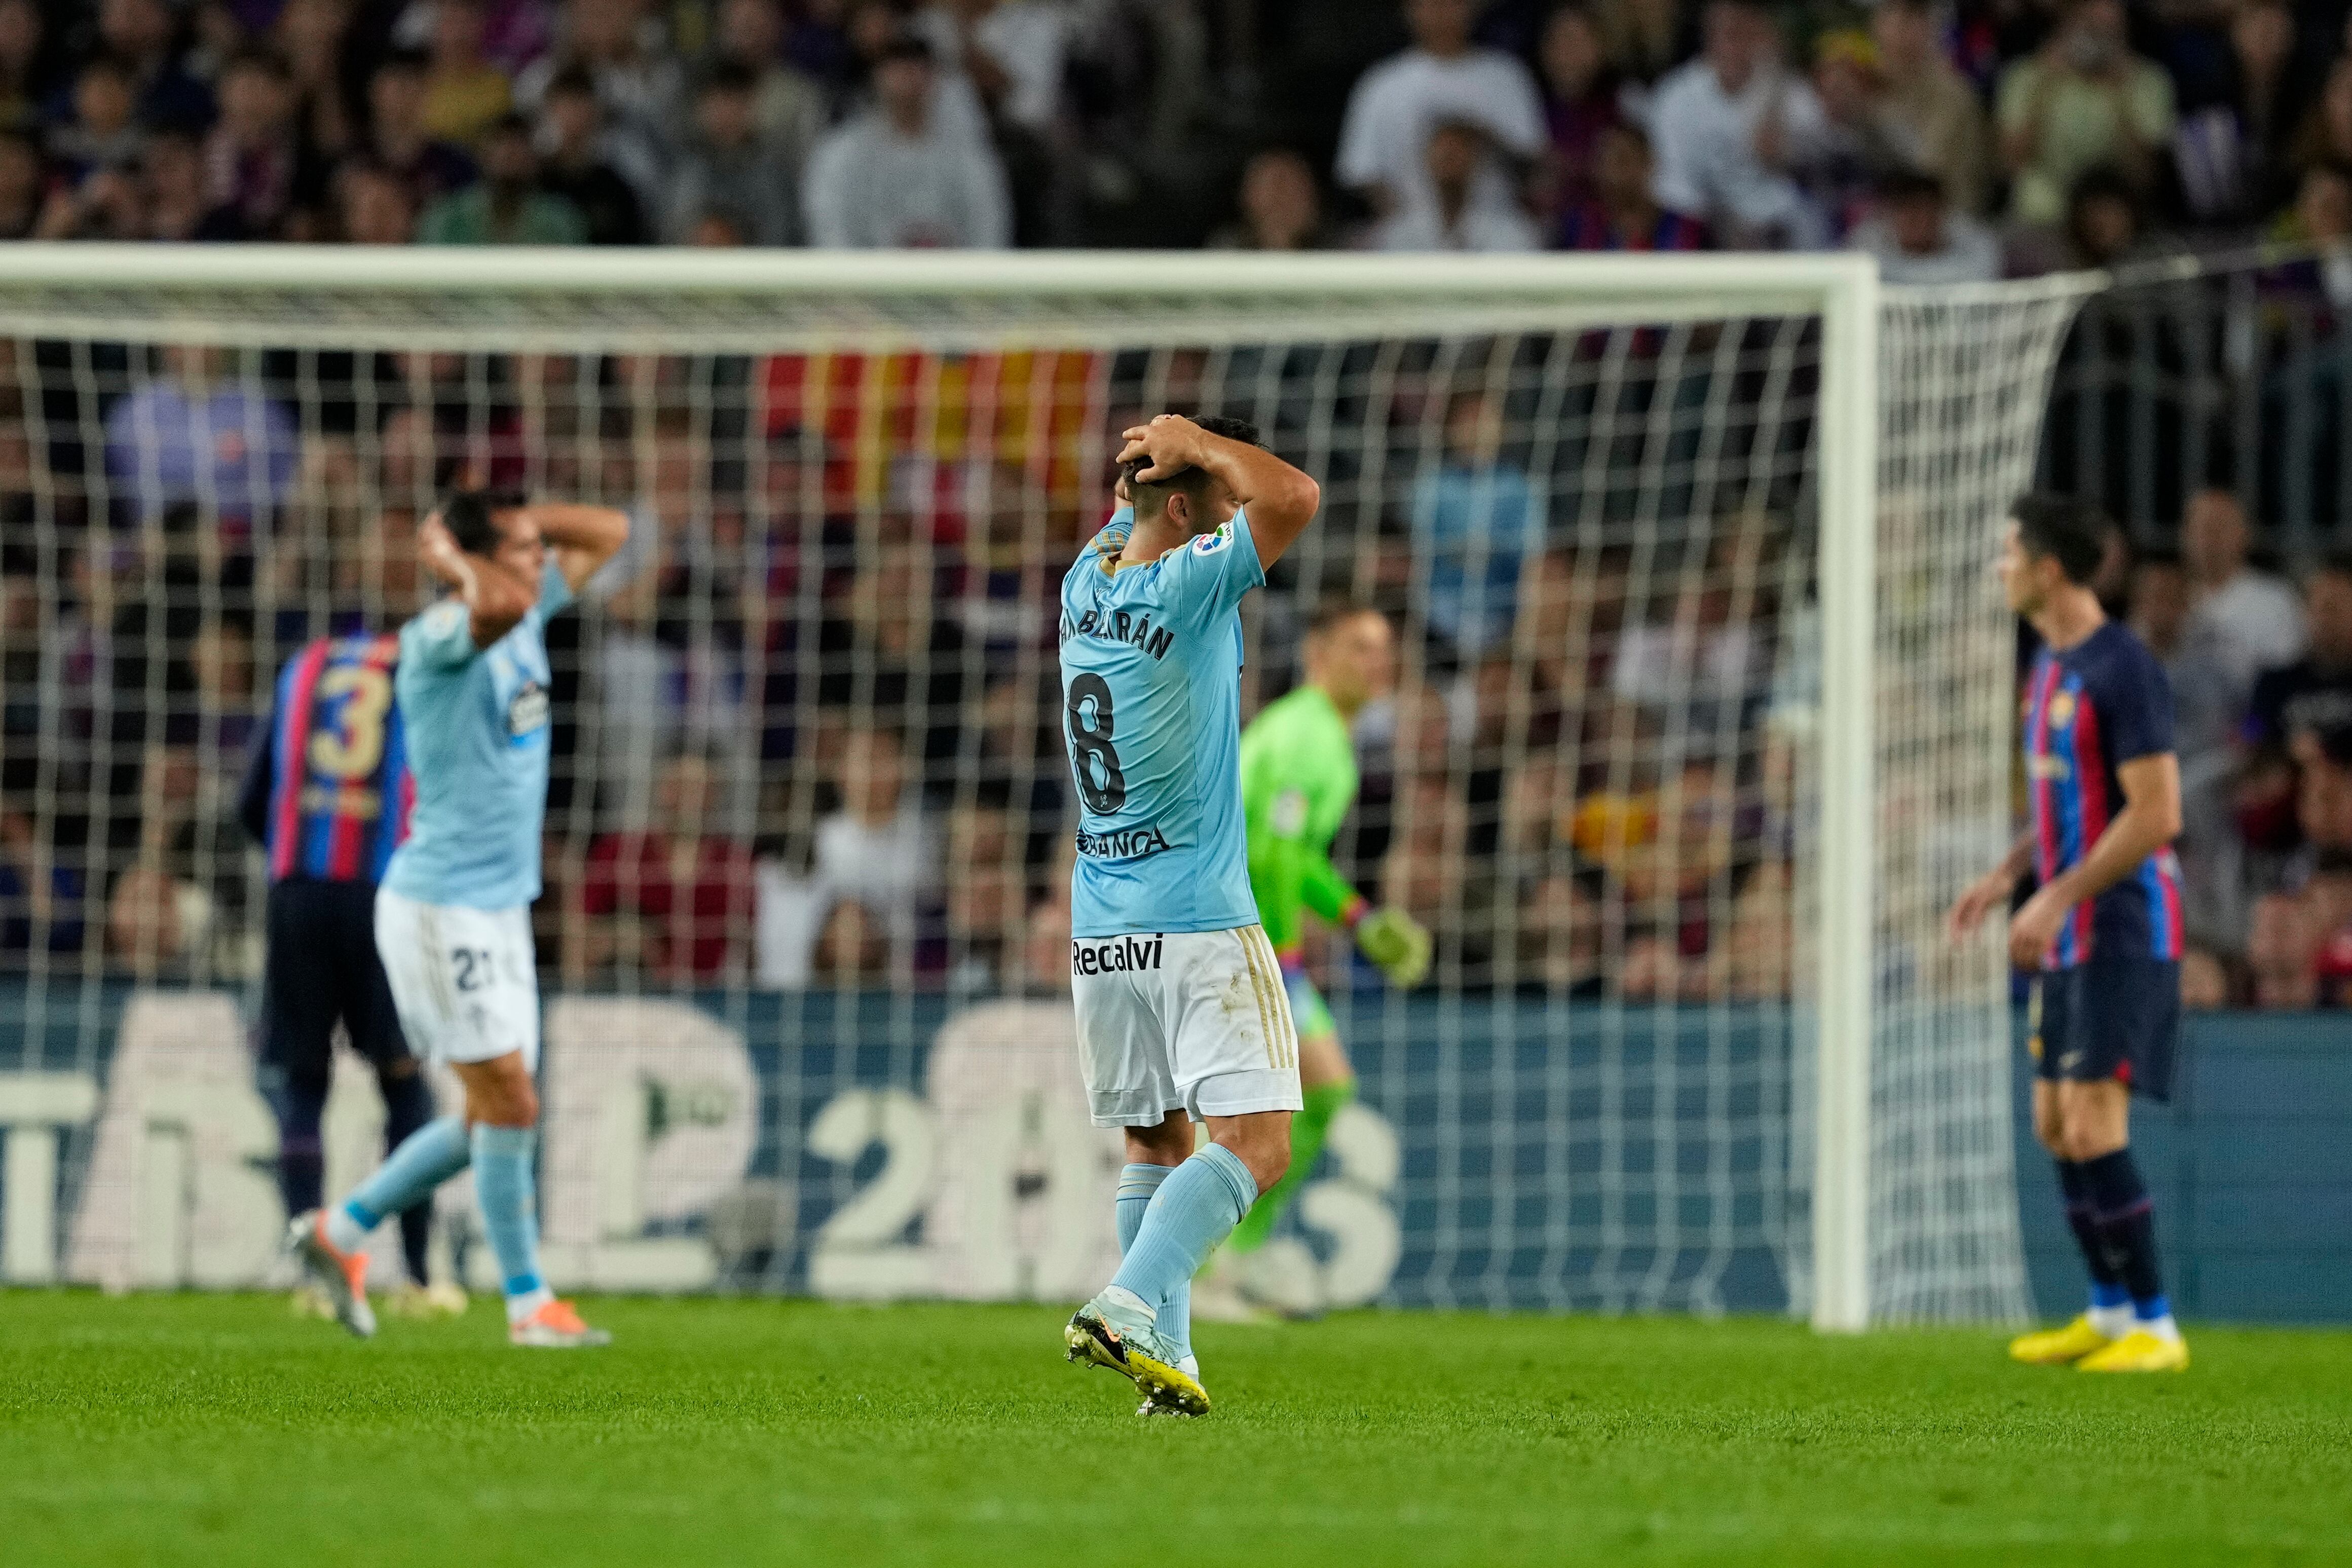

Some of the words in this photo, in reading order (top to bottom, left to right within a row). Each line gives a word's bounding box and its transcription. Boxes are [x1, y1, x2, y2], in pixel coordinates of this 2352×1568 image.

[310, 667, 393, 778] 3
[1067, 672, 1126, 816] 8
[1073, 932, 1163, 976] Recalvi
